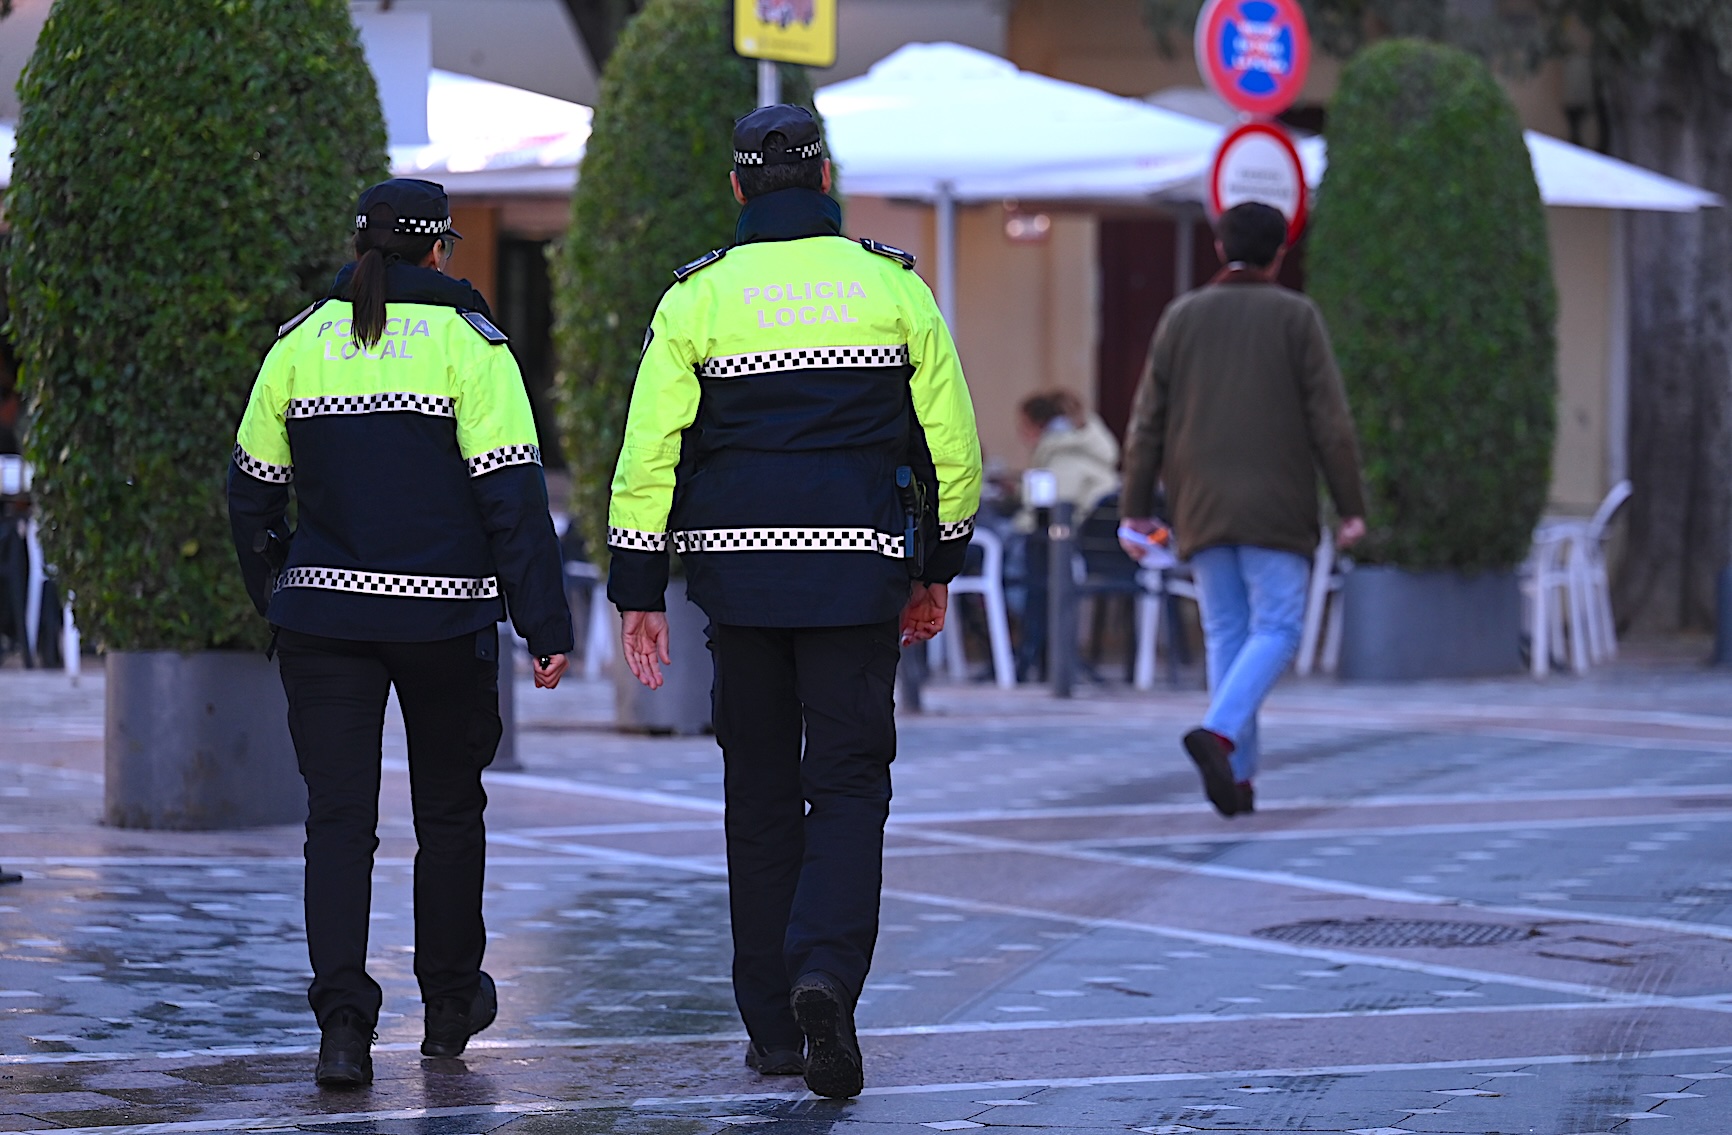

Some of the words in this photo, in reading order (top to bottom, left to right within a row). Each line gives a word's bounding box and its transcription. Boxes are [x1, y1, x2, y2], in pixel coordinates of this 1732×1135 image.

[743, 281, 867, 305] POLICIA
[317, 318, 430, 338] POCIA
[757, 304, 858, 328] LOCAL
